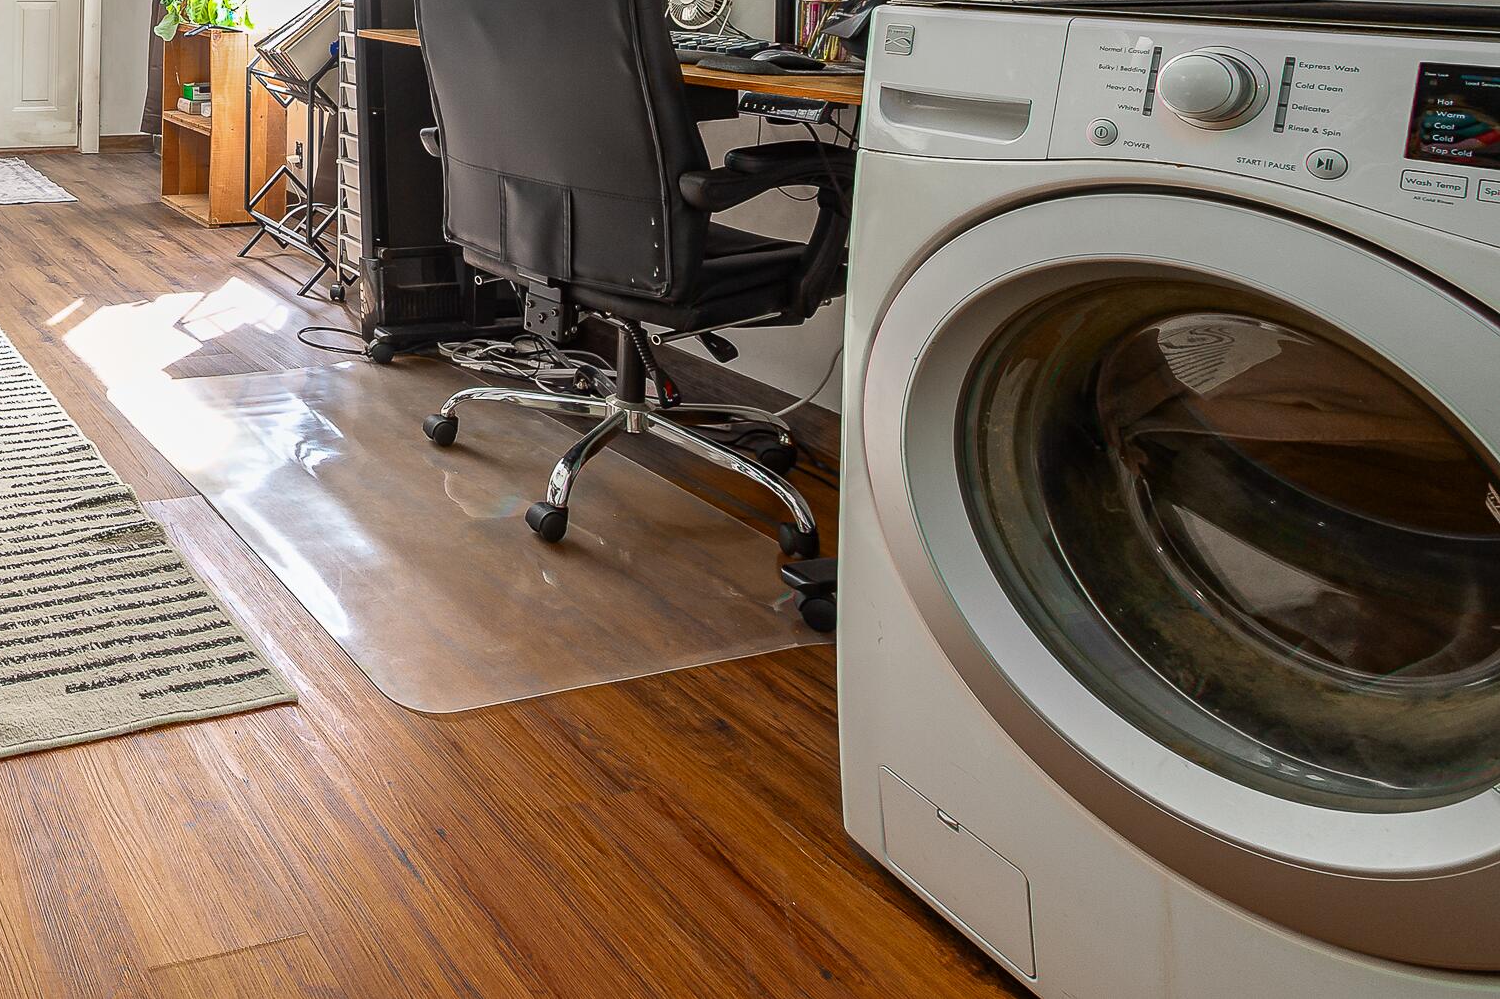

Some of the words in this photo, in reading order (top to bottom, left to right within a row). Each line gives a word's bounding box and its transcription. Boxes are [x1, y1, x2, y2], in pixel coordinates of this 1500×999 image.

[1120, 66, 1147, 74] Bedding
[1298, 62, 1331, 71] Express
[1334, 64, 1360, 73] Wash
[1105, 83, 1126, 92] Heavy
[1127, 86, 1143, 94] Duty
[1295, 82, 1315, 90] Cold
[1317, 83, 1344, 93] Clean
[1437, 98, 1454, 106] Hot
[1117, 104, 1140, 112] Whites
[1291, 103, 1331, 114] Delicates
[1435, 110, 1466, 120] Warm
[1288, 124, 1310, 133] Rinse
[1322, 128, 1341, 137] Spin
[1433, 122, 1455, 131] Cool
[1432, 134, 1454, 143] Cold
[1123, 140, 1151, 150] POWER
[1431, 146, 1449, 156] Tap
[1450, 148, 1473, 158] Cold
[1236, 156, 1262, 167] START
[1267, 161, 1297, 172] PAUSE
[1405, 177, 1432, 188] Wash
[1435, 181, 1462, 192] Temp
[1484, 187, 1500, 197] Spi
